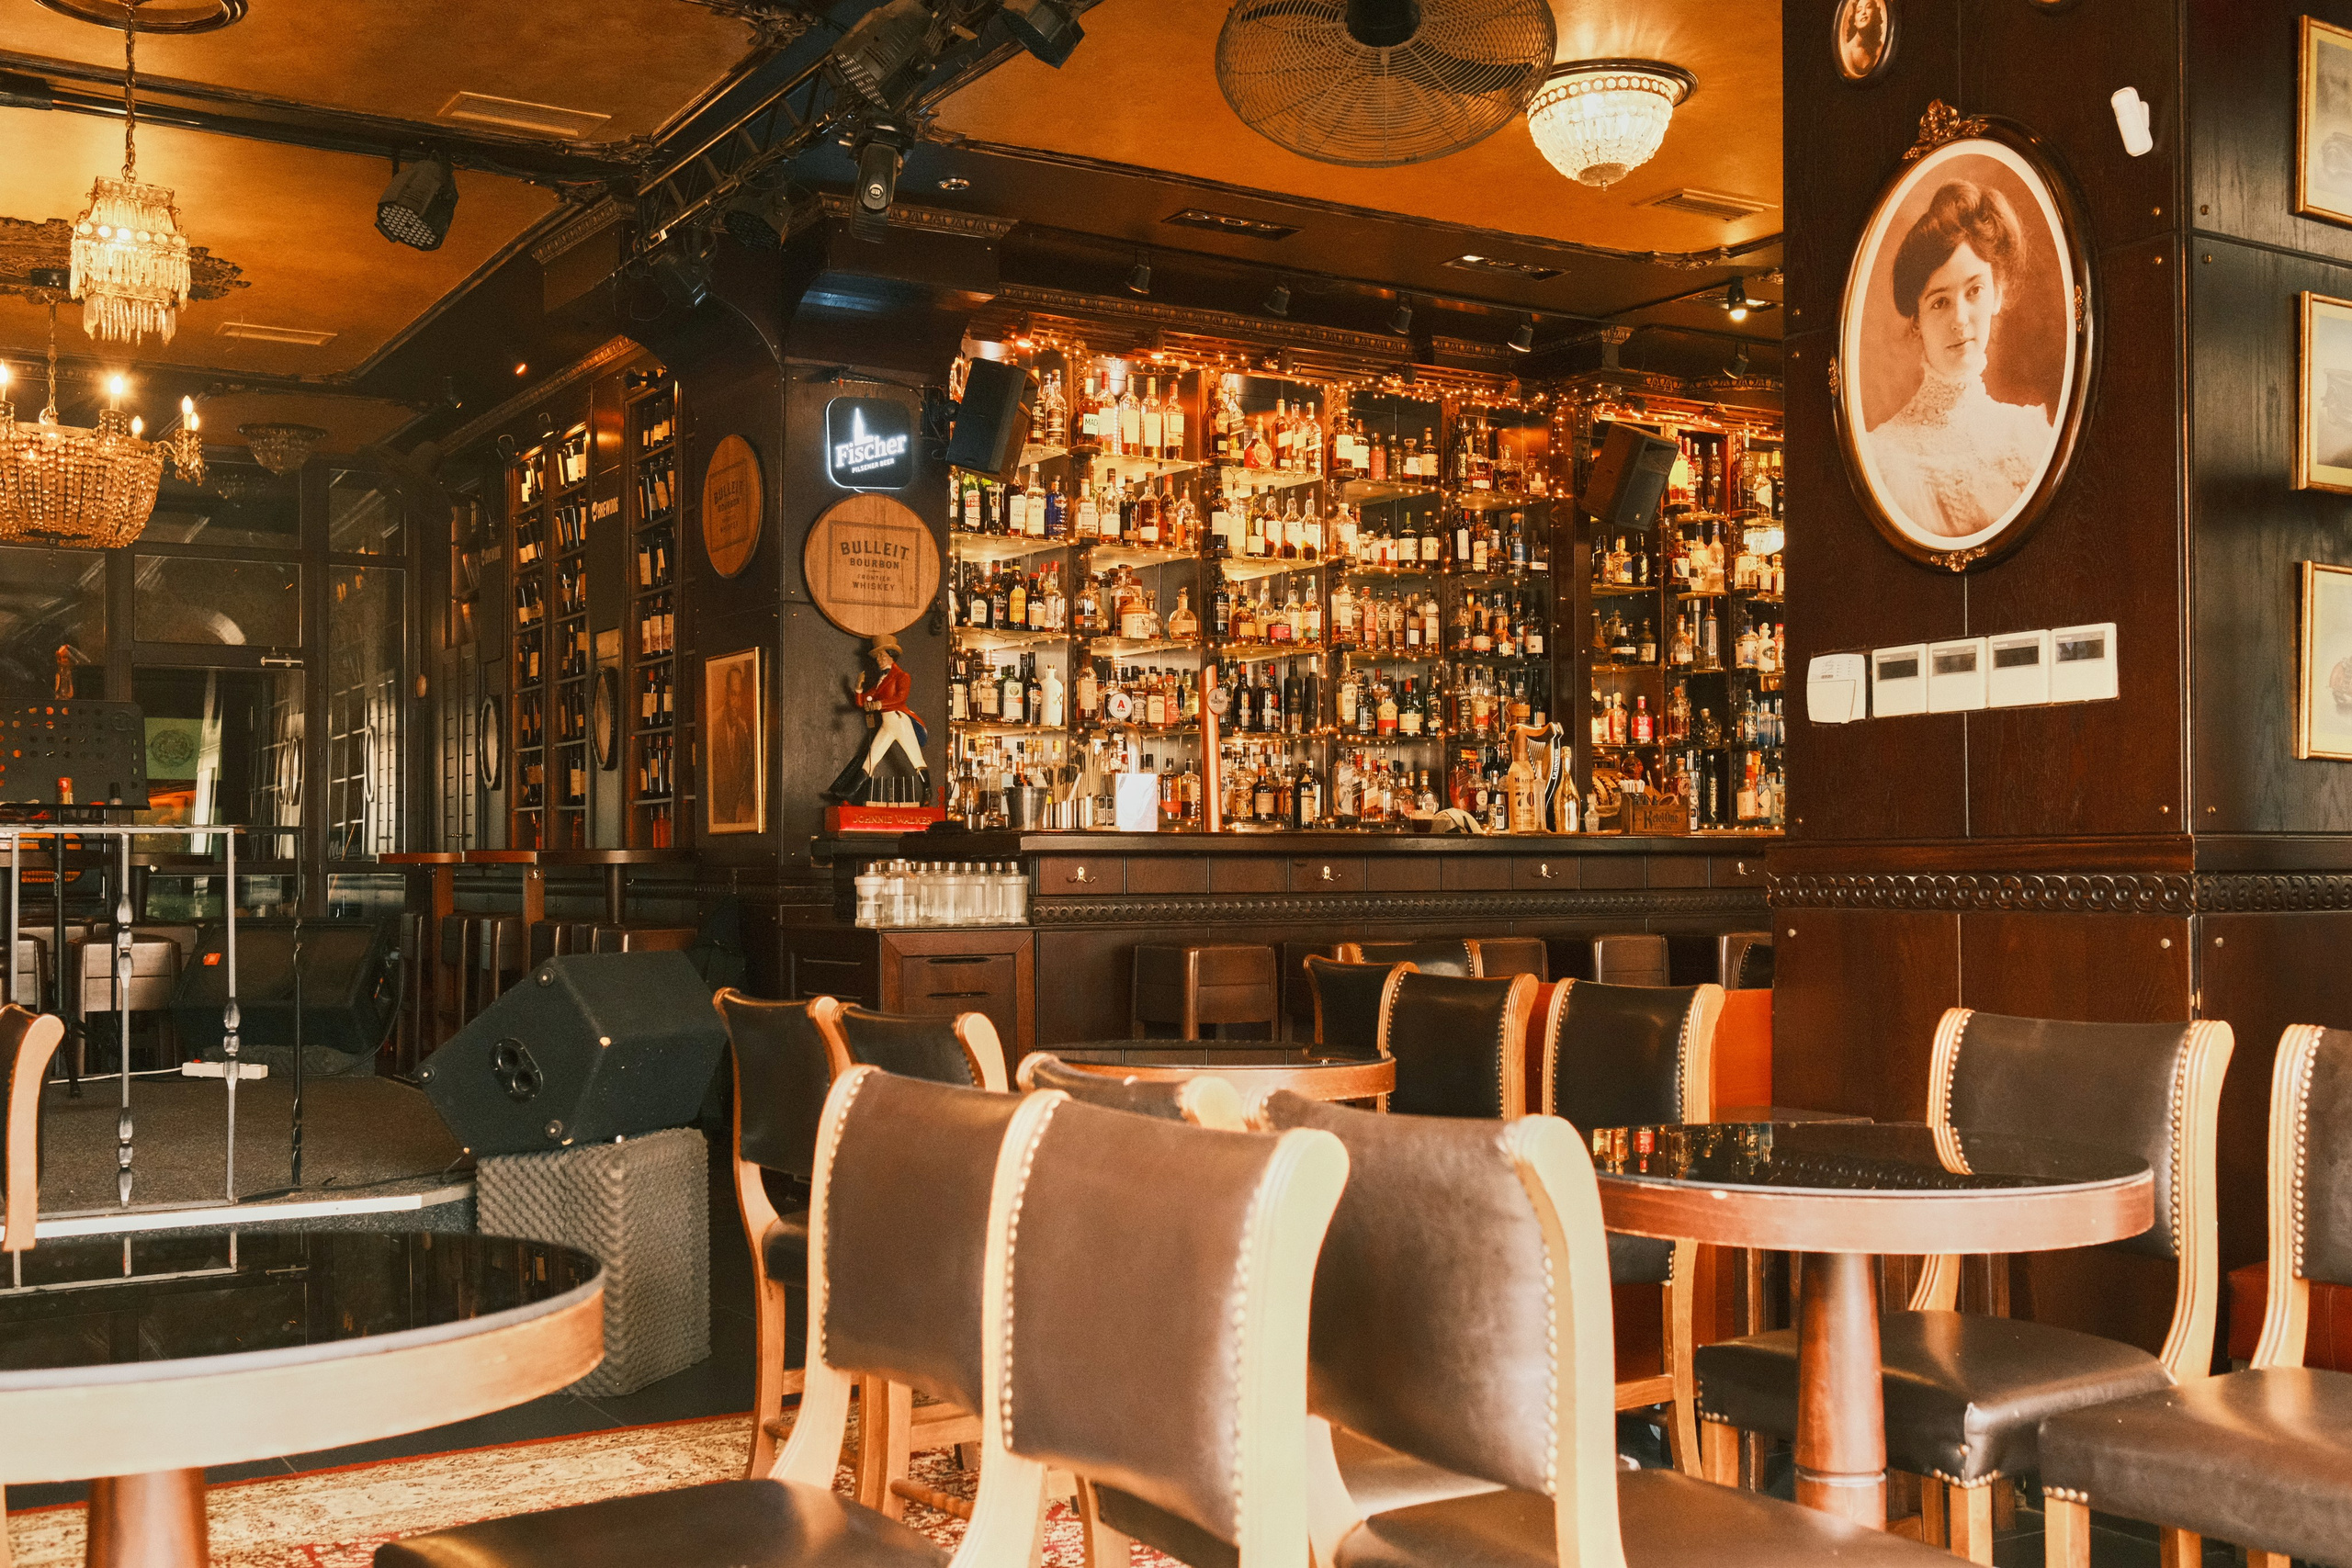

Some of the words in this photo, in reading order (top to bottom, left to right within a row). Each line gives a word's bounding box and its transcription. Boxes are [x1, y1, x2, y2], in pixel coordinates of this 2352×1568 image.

[835, 434, 907, 468] Fischer
[851, 461, 879, 474] PILSENER
[879, 457, 895, 467] BEER
[841, 540, 910, 560] BULLEIT
[850, 558, 899, 570] BOURBON
[857, 573, 890, 581] FRONTIER
[853, 581, 895, 591] WHISKEY
[1117, 699, 1125, 708] A
[1552, 748, 1560, 779] GUINNESS
[853, 814, 893, 823] JOHNNIE
[894, 814, 933, 825] WALKER
